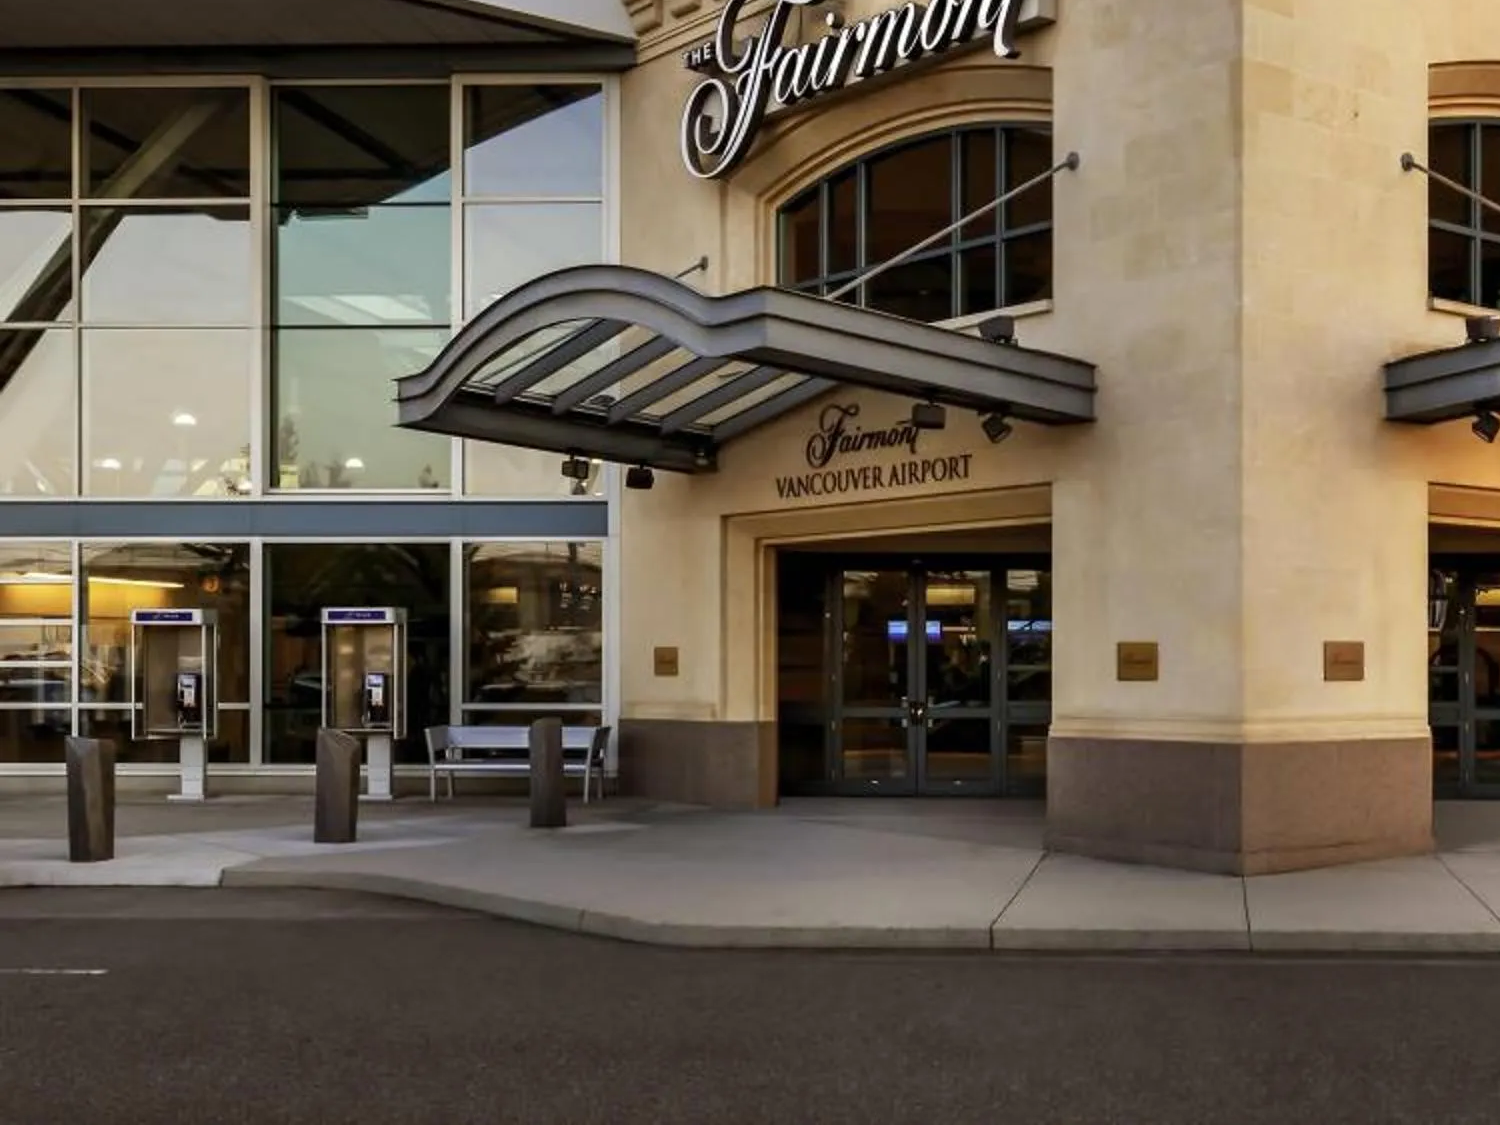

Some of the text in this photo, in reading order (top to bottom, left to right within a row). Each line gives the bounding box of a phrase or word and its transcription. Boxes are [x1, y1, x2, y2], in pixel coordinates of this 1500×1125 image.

[682, 42, 711, 68] THE
[776, 454, 973, 499] VANCOUVER AIRPORT
